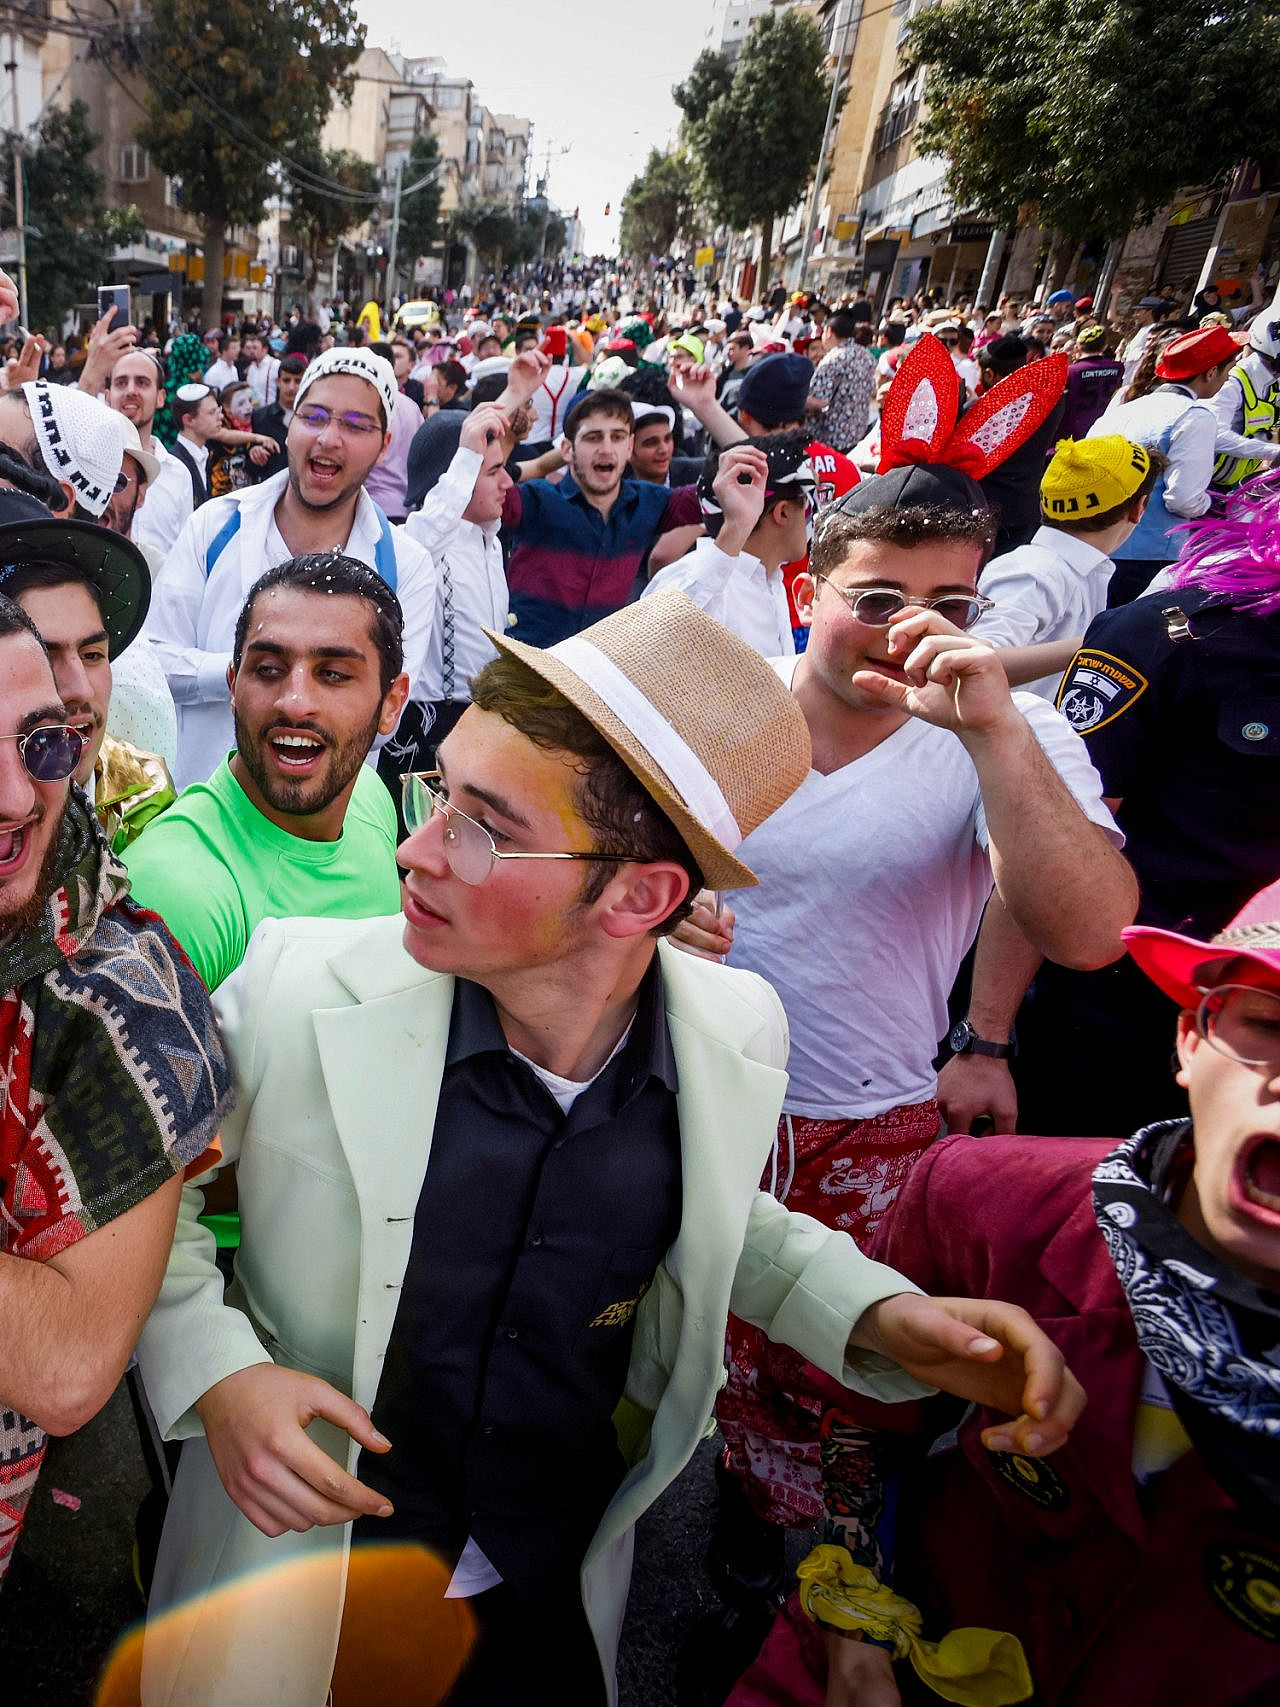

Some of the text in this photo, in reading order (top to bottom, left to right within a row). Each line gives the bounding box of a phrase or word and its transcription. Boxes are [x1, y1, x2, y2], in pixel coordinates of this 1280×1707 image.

[1052, 497, 1079, 513] נח
[1077, 655, 1137, 690] משטרת ישראל
